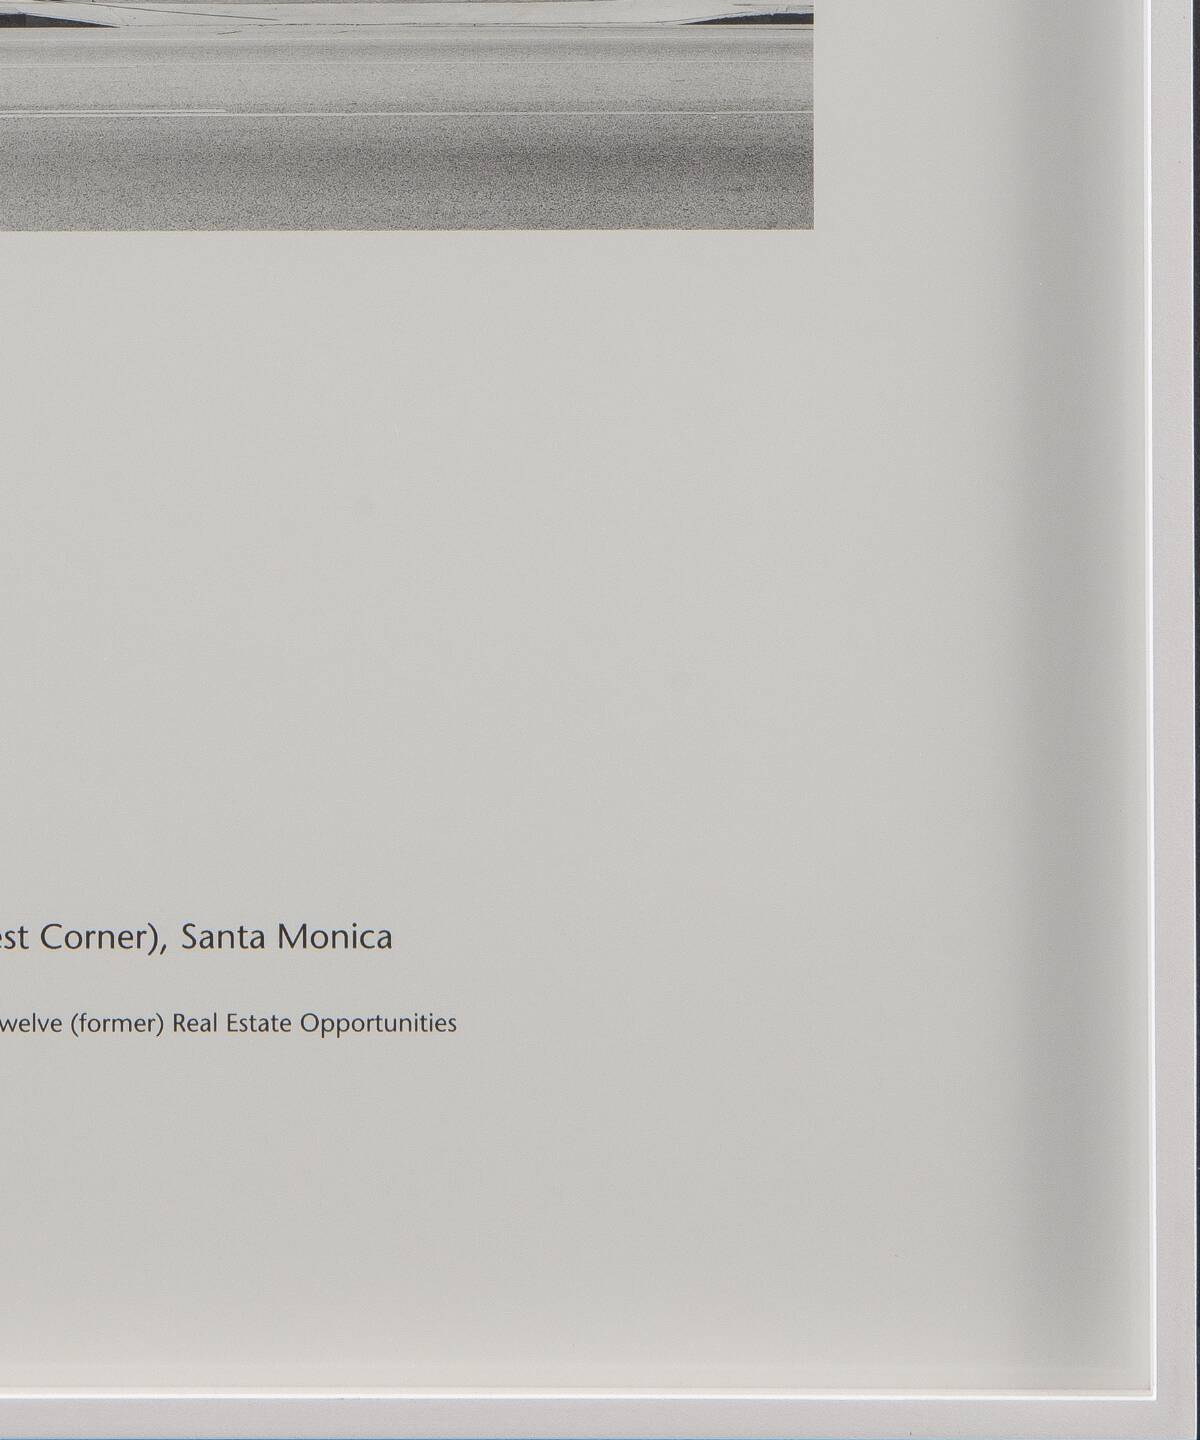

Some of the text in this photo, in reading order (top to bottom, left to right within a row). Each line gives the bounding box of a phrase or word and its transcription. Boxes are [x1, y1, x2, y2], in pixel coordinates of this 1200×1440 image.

[40, 922, 167, 957] Corner),
[181, 922, 265, 951] Santa
[278, 922, 392, 951] Monica
[70, 1012, 164, 1038] (former)
[173, 1012, 217, 1034] Real
[227, 1013, 292, 1034] Estate
[300, 1012, 457, 1039] Opportunities
